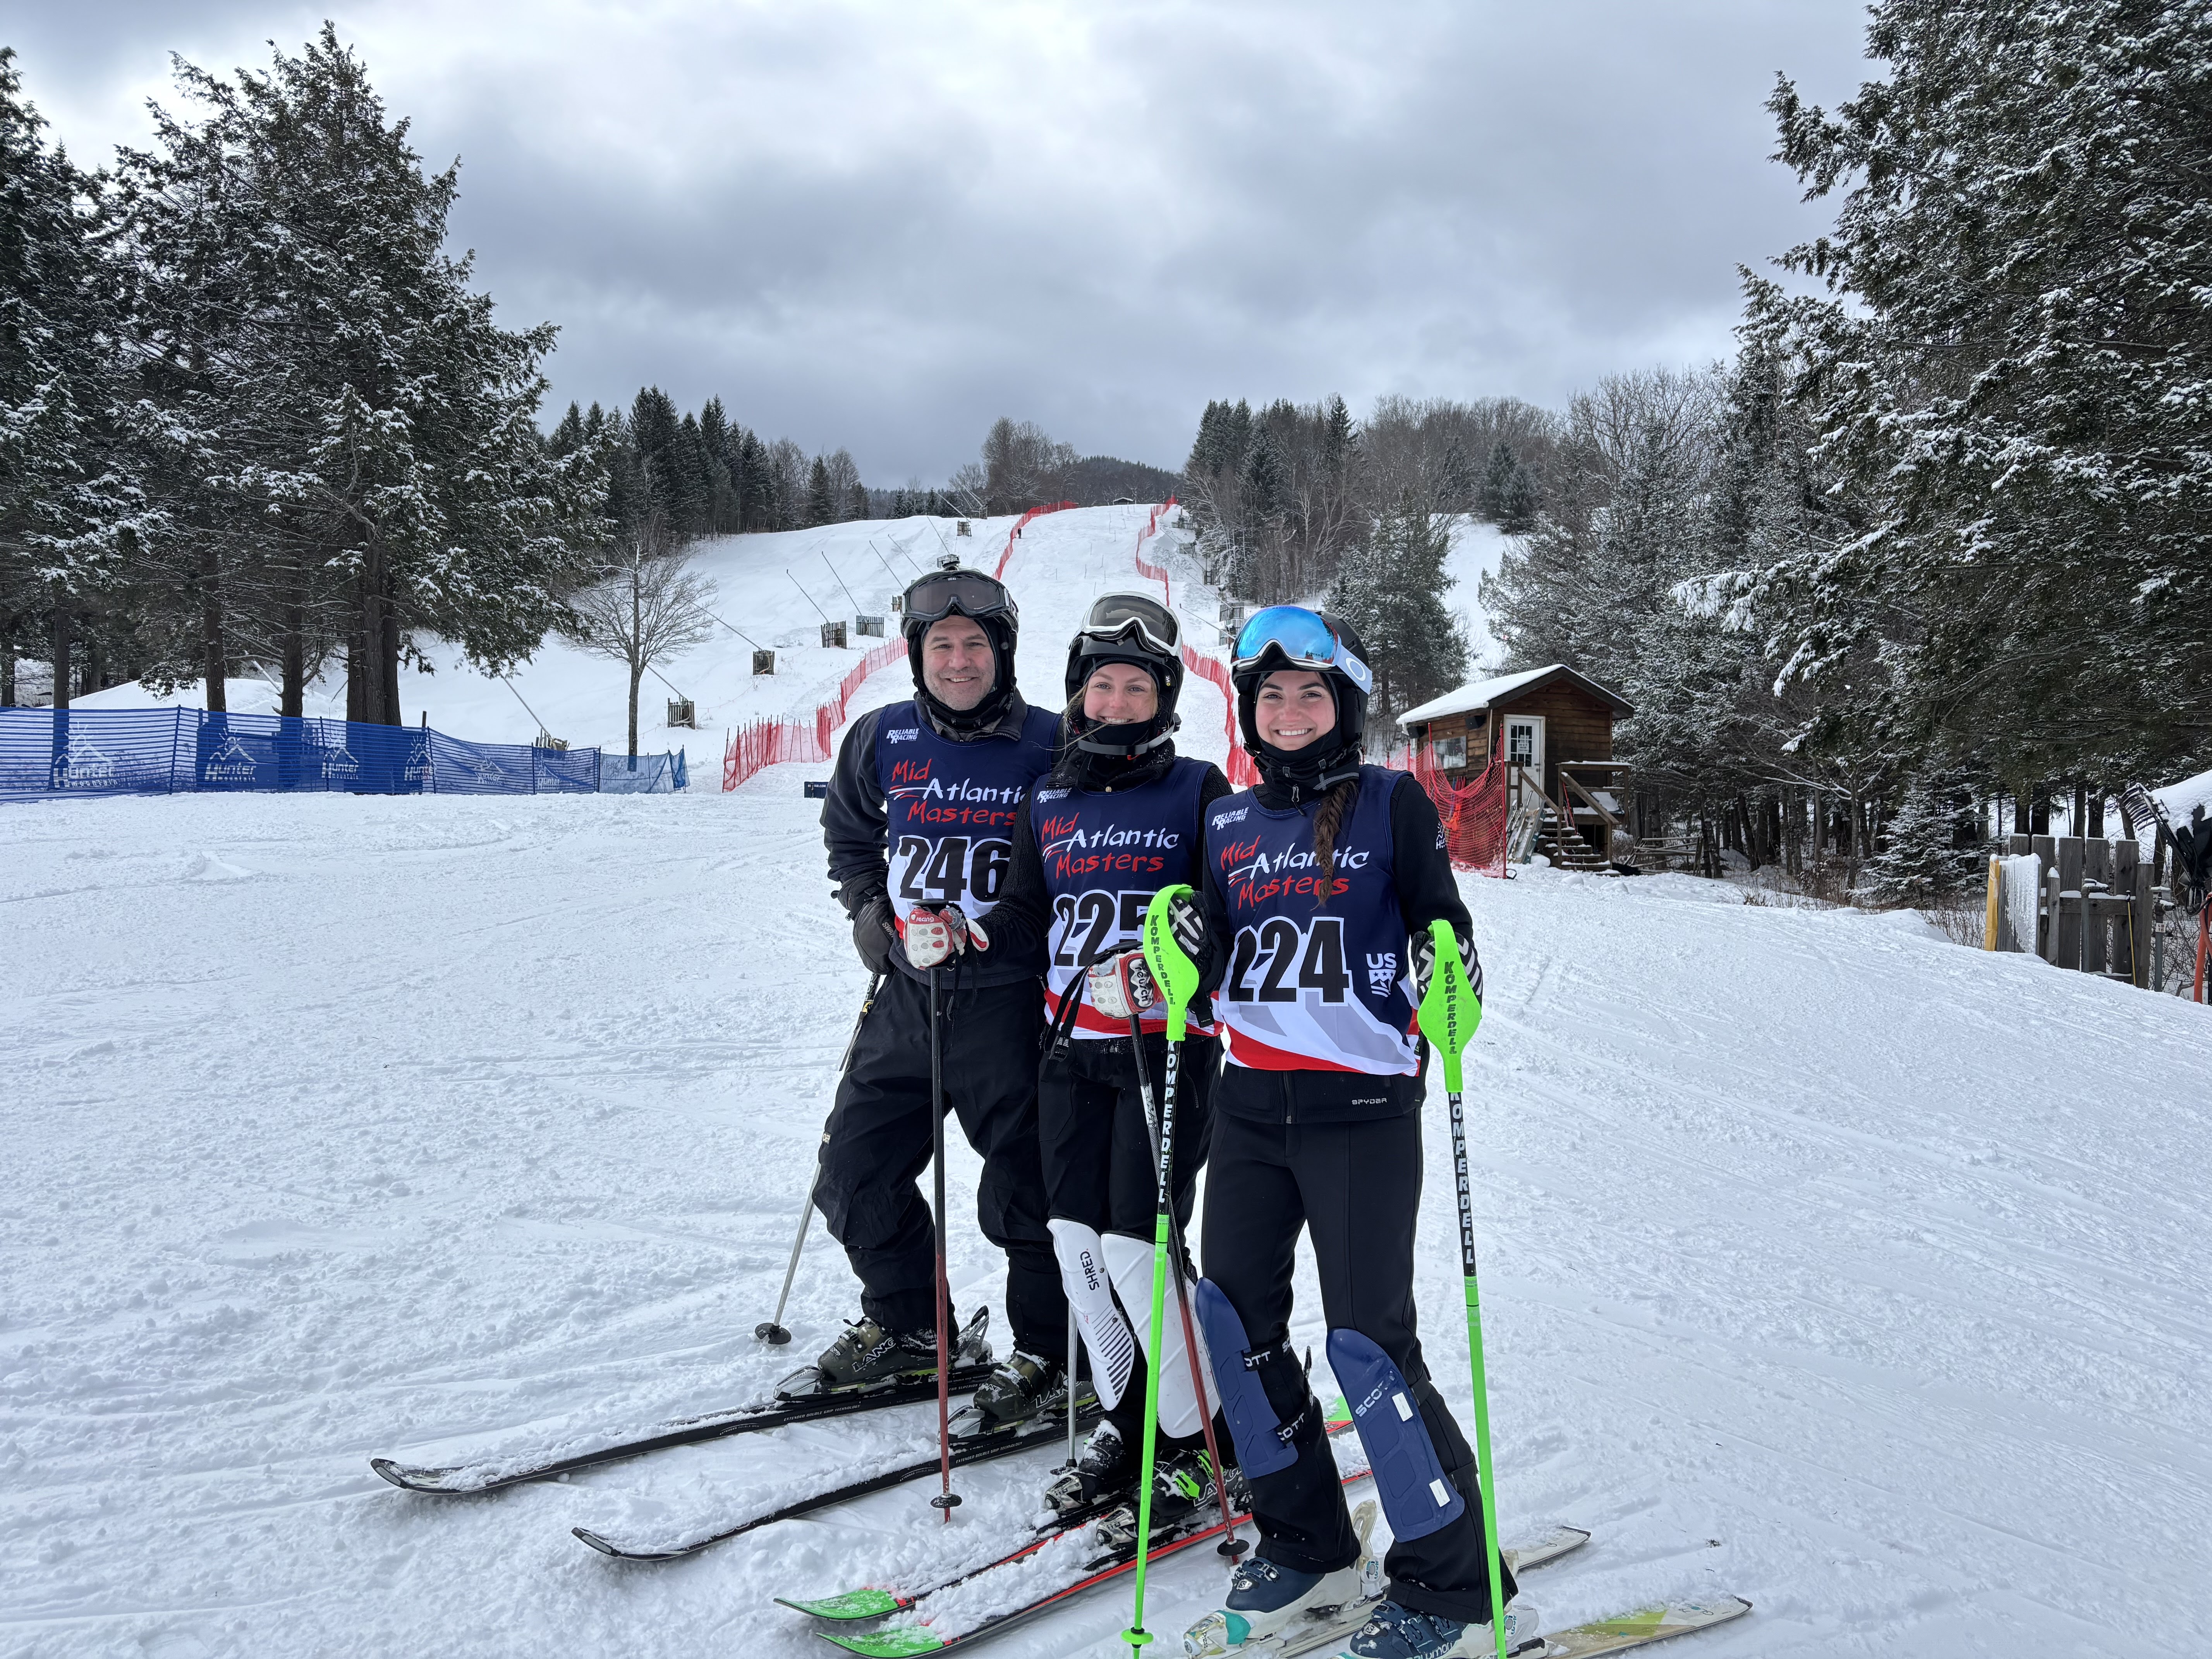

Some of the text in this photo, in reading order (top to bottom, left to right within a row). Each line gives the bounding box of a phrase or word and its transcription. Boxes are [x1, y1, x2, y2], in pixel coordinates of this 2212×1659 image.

[886, 728, 919, 738] RELIABLE
[891, 734, 918, 744] RACING
[891, 758, 932, 783] Mid
[1037, 788, 1072, 800] RELIABLE
[1039, 793, 1068, 803] RACING
[907, 800, 1018, 826] Masters
[1212, 807, 1249, 826] RELIABLE
[1217, 814, 1247, 830] RACING
[1042, 812, 1079, 842] Mid
[1066, 824, 1179, 852] Atlantic
[1056, 852, 1164, 879] Masters
[1221, 835, 1261, 871] Mid
[898, 836, 1012, 903] 246
[1053, 890, 1151, 967] 225
[1150, 915, 1175, 1005] KOMPERDELL
[1228, 917, 1351, 1004] 224
[1366, 953, 1397, 969] US
[1444, 961, 1457, 1054] KOMPERDELL
[1158, 1040, 1176, 1203] KOMPERDELL
